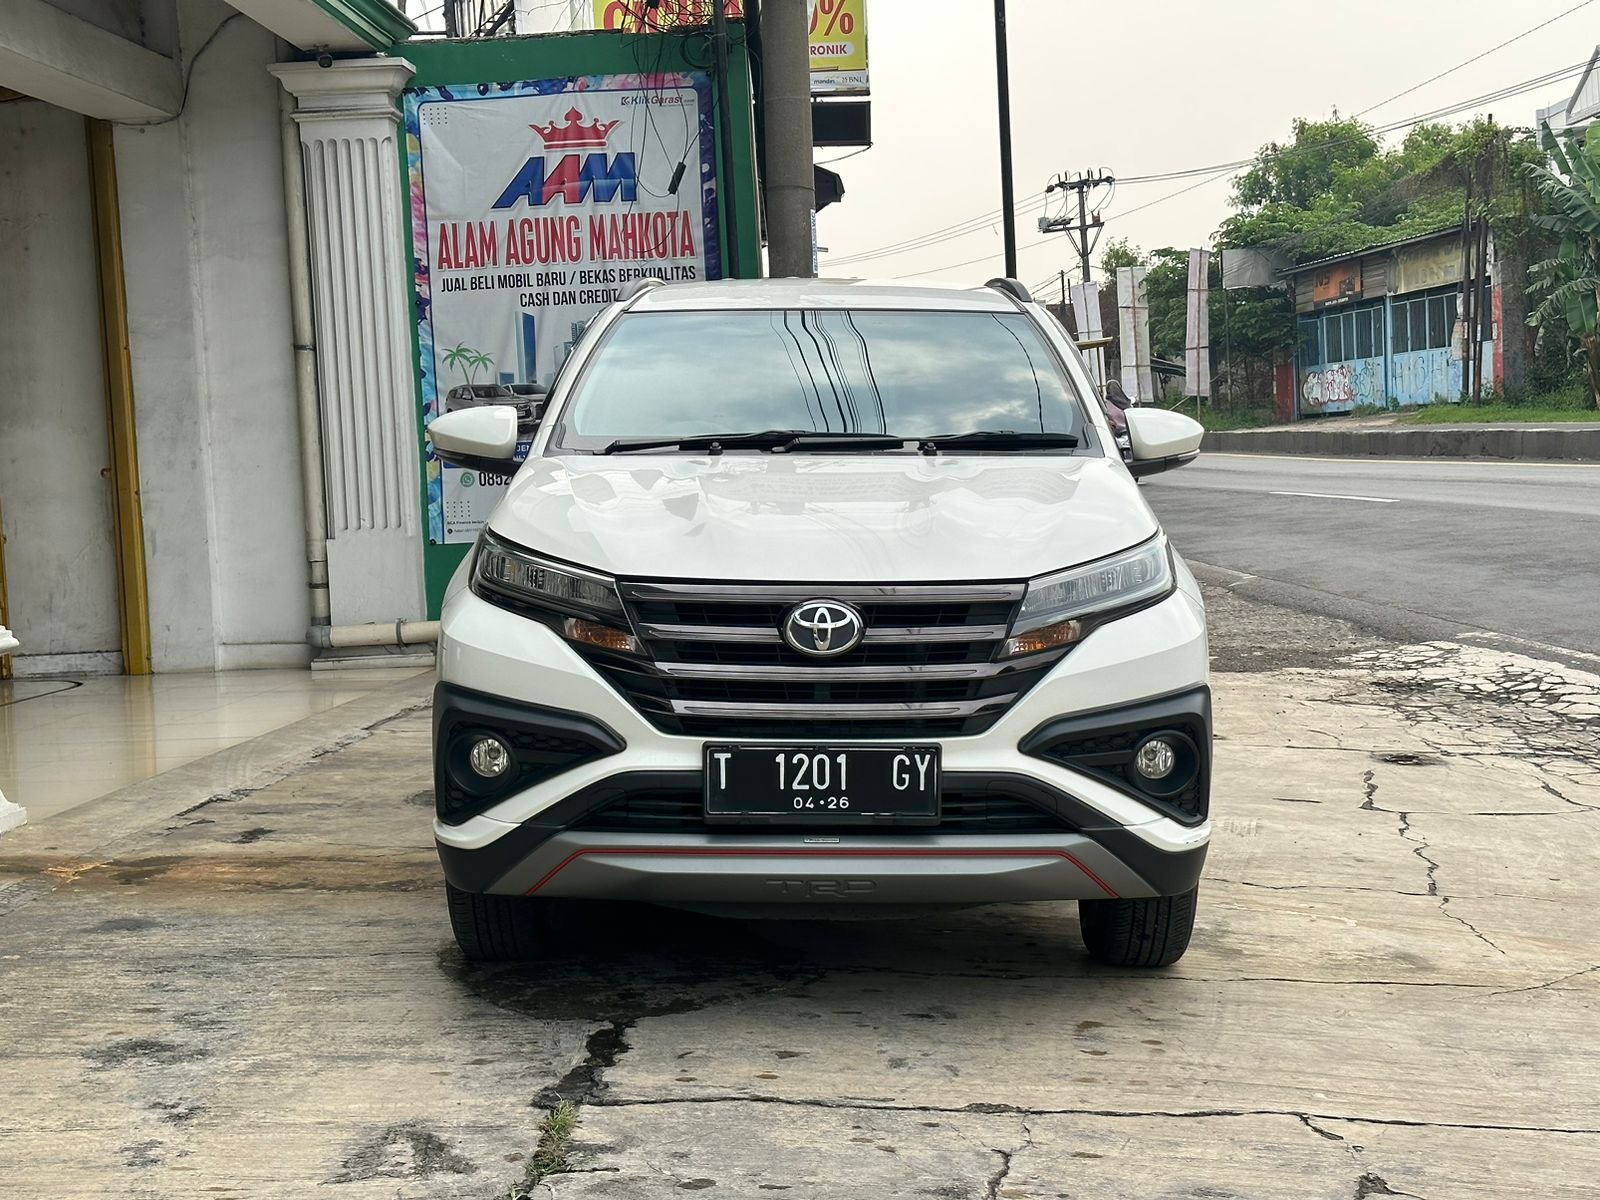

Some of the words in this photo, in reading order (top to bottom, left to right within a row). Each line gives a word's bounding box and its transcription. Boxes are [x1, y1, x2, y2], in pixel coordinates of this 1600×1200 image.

[491, 152, 637, 209] AAM
[437, 221, 498, 270] ALAM
[505, 215, 581, 266] AGUNG
[589, 210, 696, 261] MAHKOTA
[441, 276, 467, 292] JUAL
[470, 275, 495, 290] BELI
[497, 273, 533, 289] MOBIL
[536, 271, 566, 286] BARU
[579, 268, 616, 284] BEKAS
[619, 265, 696, 282] BERKUALITAS
[520, 291, 549, 307] CASH
[552, 290, 577, 305] DAN
[580, 288, 618, 303] CREDIT
[714, 752, 731, 790] T
[775, 753, 847, 791] 1201
[892, 754, 931, 791] GY
